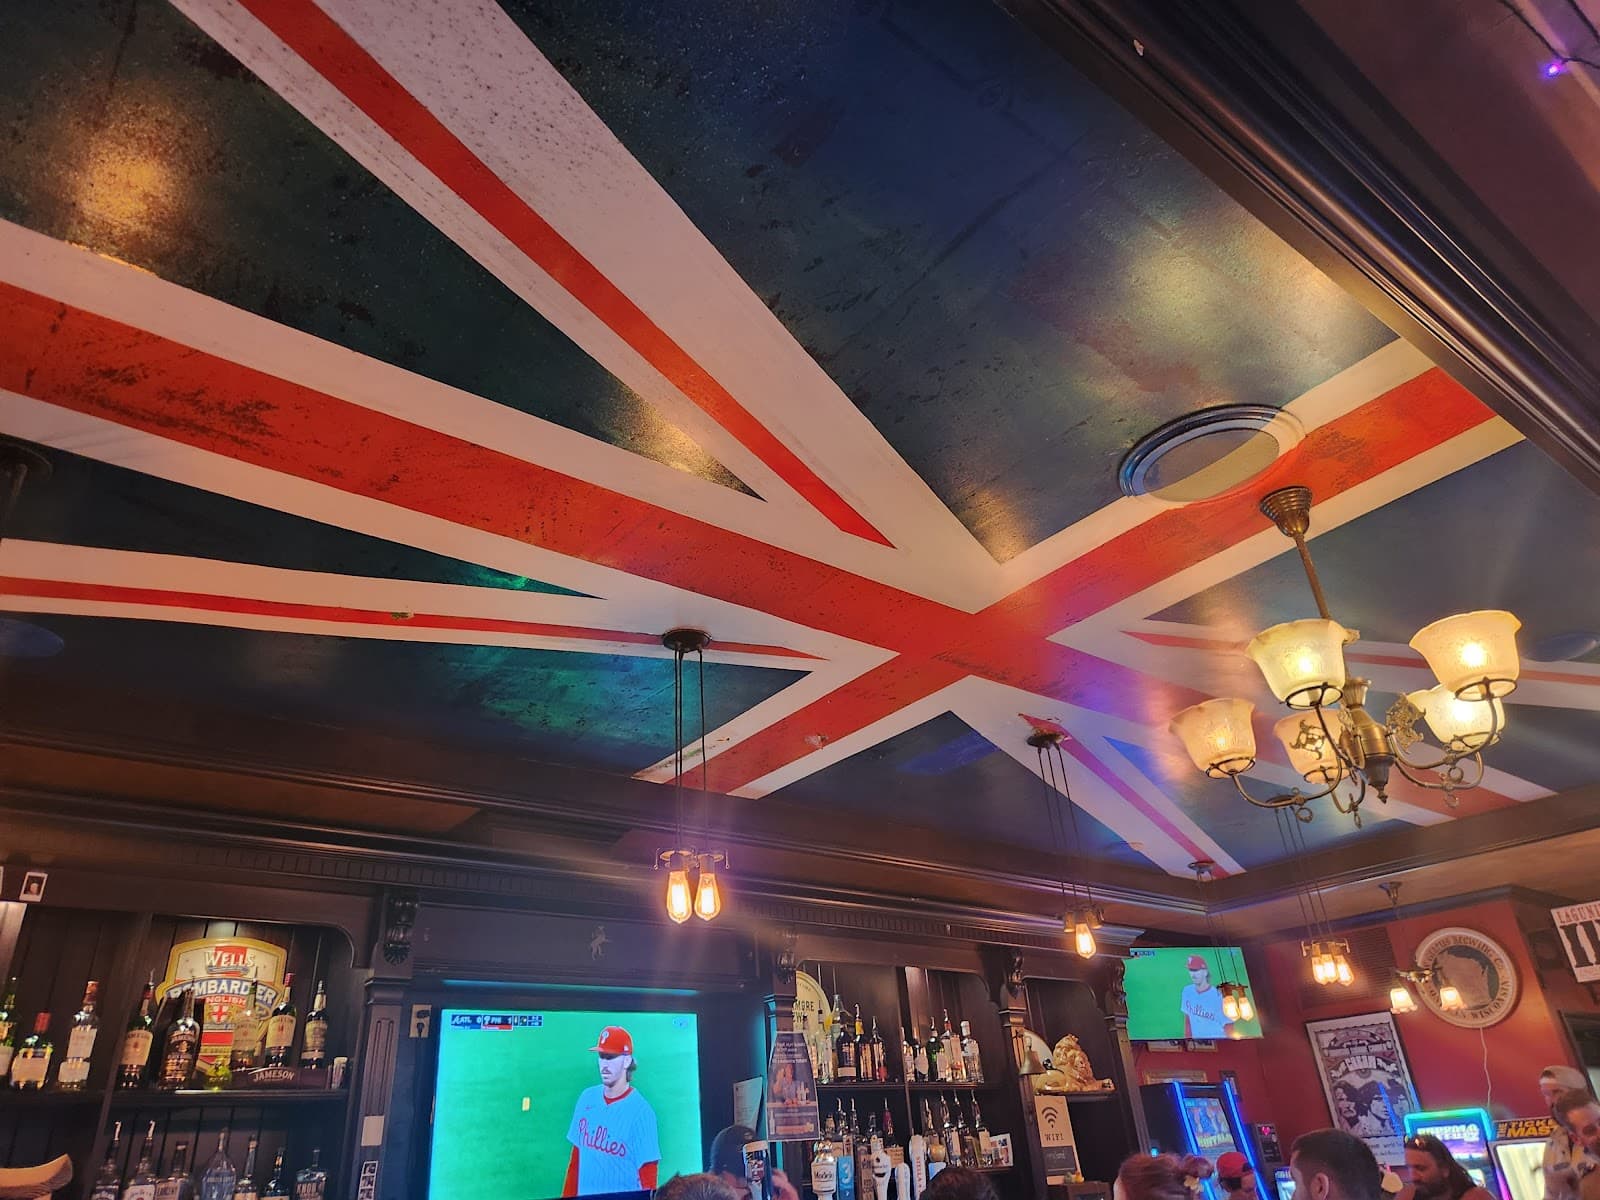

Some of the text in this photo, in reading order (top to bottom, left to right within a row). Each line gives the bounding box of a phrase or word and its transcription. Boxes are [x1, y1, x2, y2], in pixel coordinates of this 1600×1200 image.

[205, 950, 256, 967] WELLS
[168, 979, 277, 1004] BMBARDER
[794, 1001, 815, 1012] MORE
[254, 1069, 296, 1081] JAMESON
[579, 1118, 626, 1157] Phillies
[1045, 1133, 1065, 1141] WIFI
